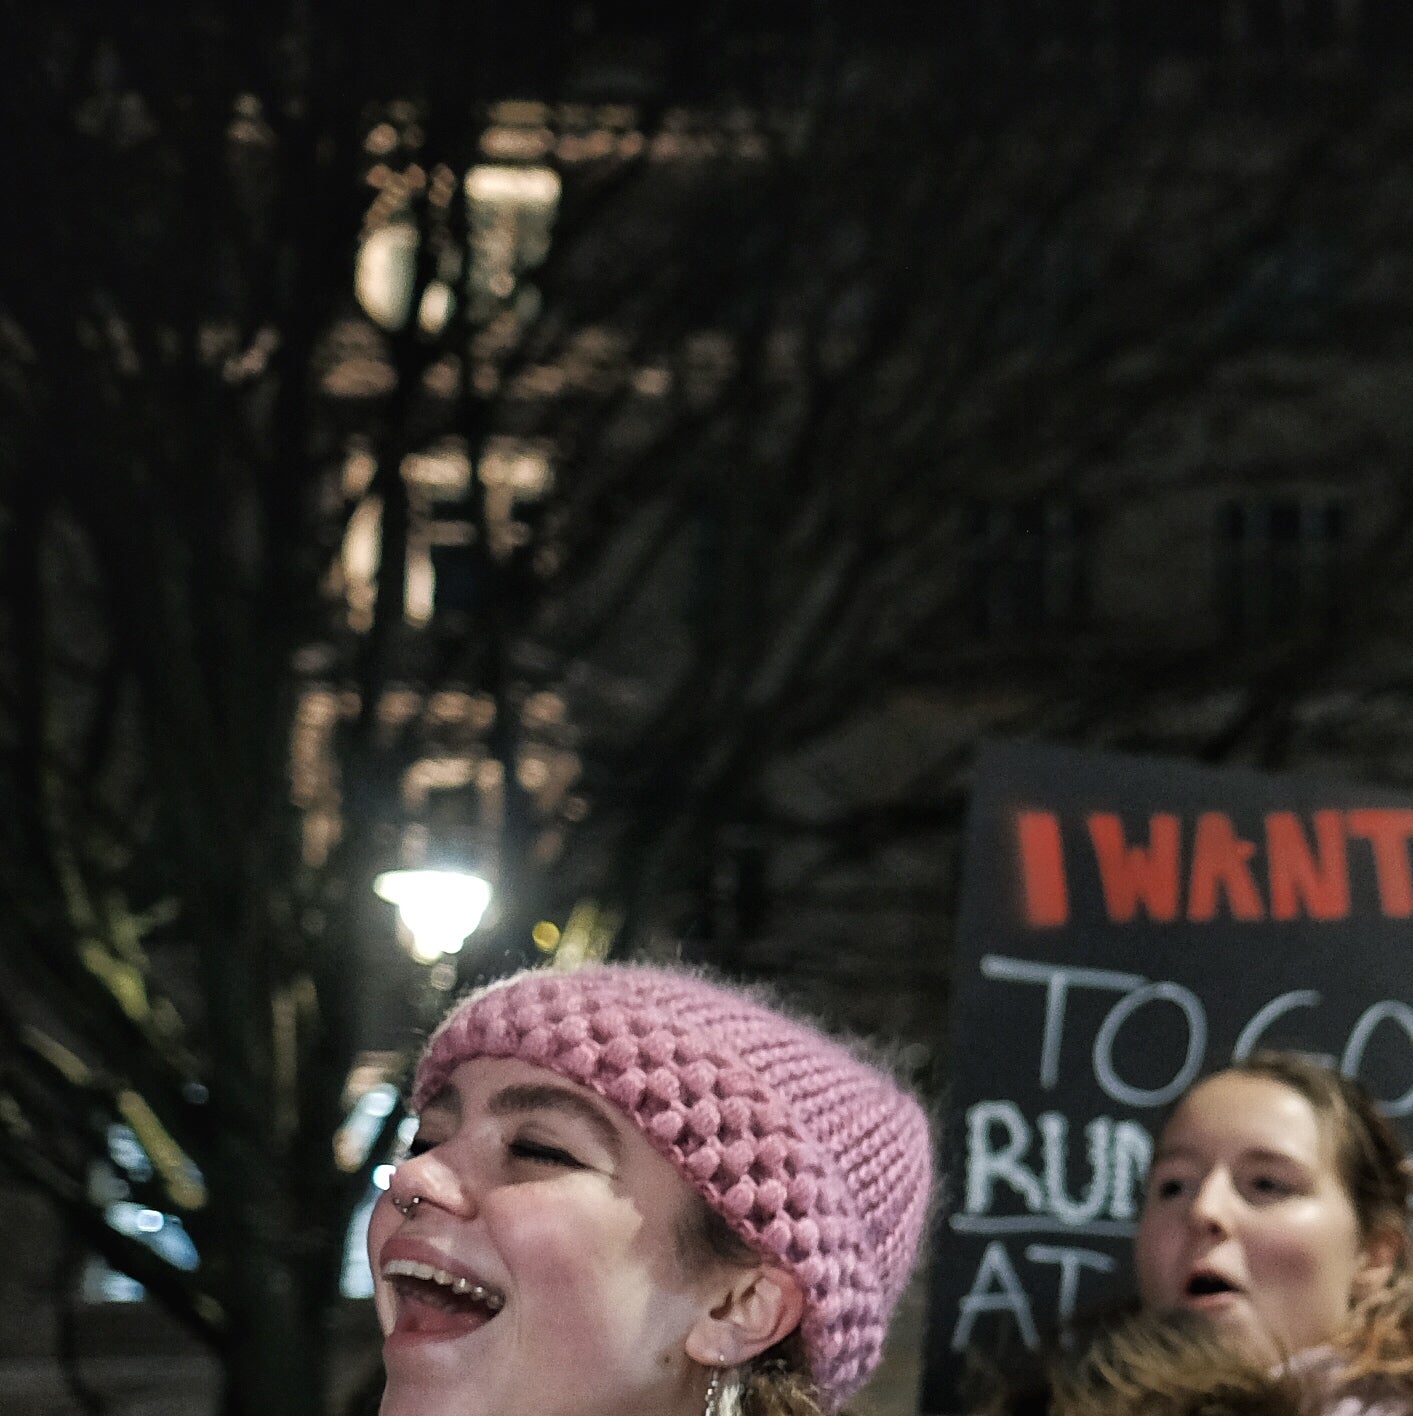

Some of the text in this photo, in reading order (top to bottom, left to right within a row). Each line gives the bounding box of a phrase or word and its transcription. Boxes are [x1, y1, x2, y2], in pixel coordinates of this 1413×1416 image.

[1016, 810, 1068, 928] I
[980, 954, 1208, 1108] TO
[964, 1101, 1154, 1225] RUN
[950, 1239, 1116, 1351] AT
